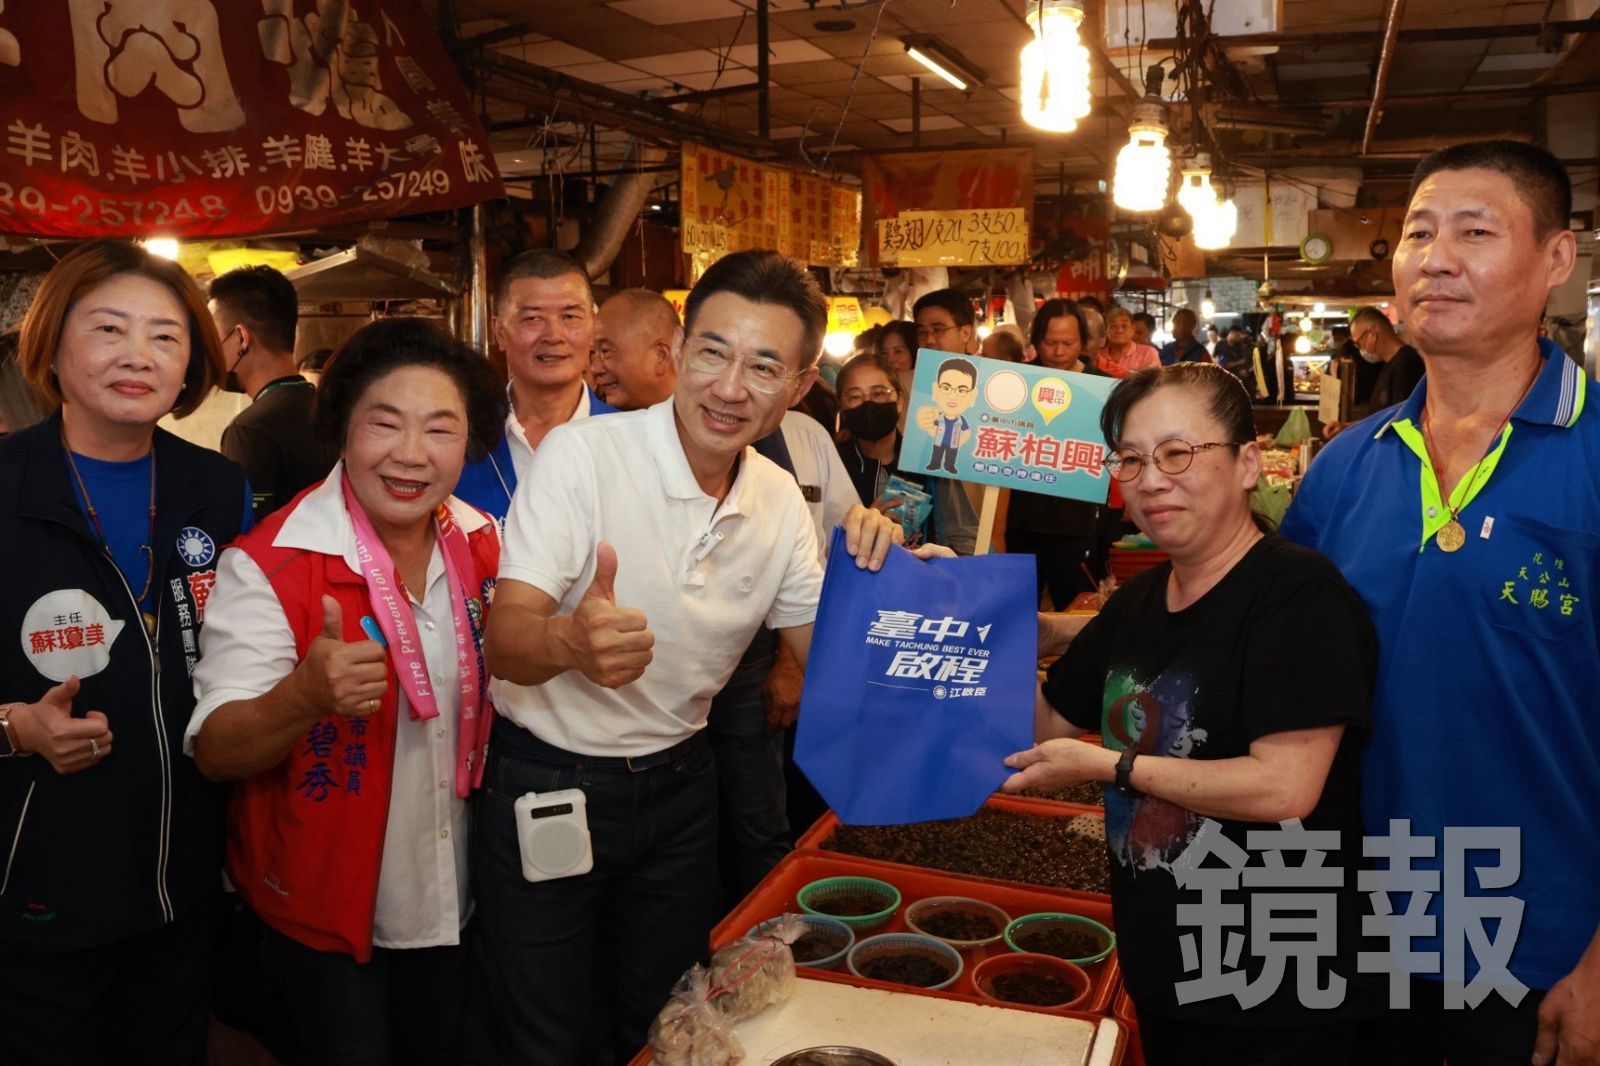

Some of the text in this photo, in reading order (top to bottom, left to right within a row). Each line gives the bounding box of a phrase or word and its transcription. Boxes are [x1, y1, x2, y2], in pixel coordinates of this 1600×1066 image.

[974, 427, 1104, 477] 蘇柏興
[1518, 566, 1570, 588] 天公山
[370, 567, 416, 654] Prevention
[1499, 580, 1580, 616] 天賜宮
[54, 612, 83, 626] 主任
[866, 609, 970, 643] 臺中
[29, 623, 105, 654] 蘇瓊美
[866, 637, 990, 657] MAKE TAICHUNG BEST EVER
[409, 661, 430, 697] Fire
[886, 651, 989, 684] 啟程
